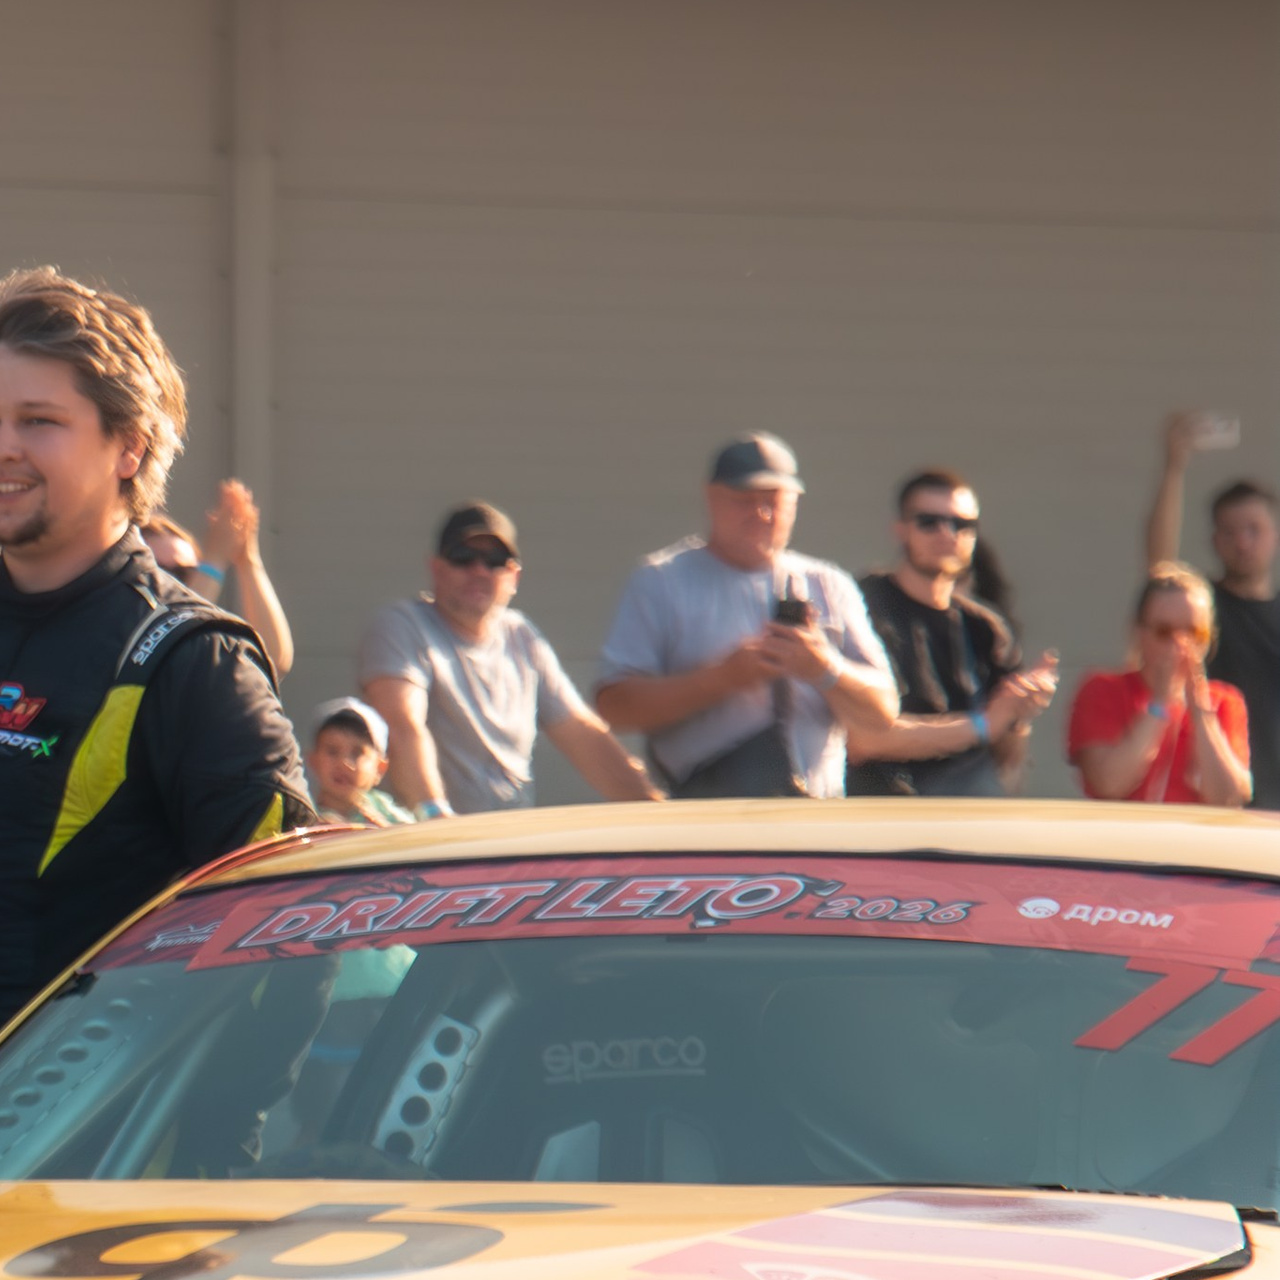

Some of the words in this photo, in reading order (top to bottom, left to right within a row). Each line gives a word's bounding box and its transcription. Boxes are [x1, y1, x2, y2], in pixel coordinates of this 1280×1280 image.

[232, 880, 558, 950] DRIFT
[532, 874, 807, 921] LETO
[813, 894, 974, 925] 2026
[1072, 955, 1280, 1068] 77
